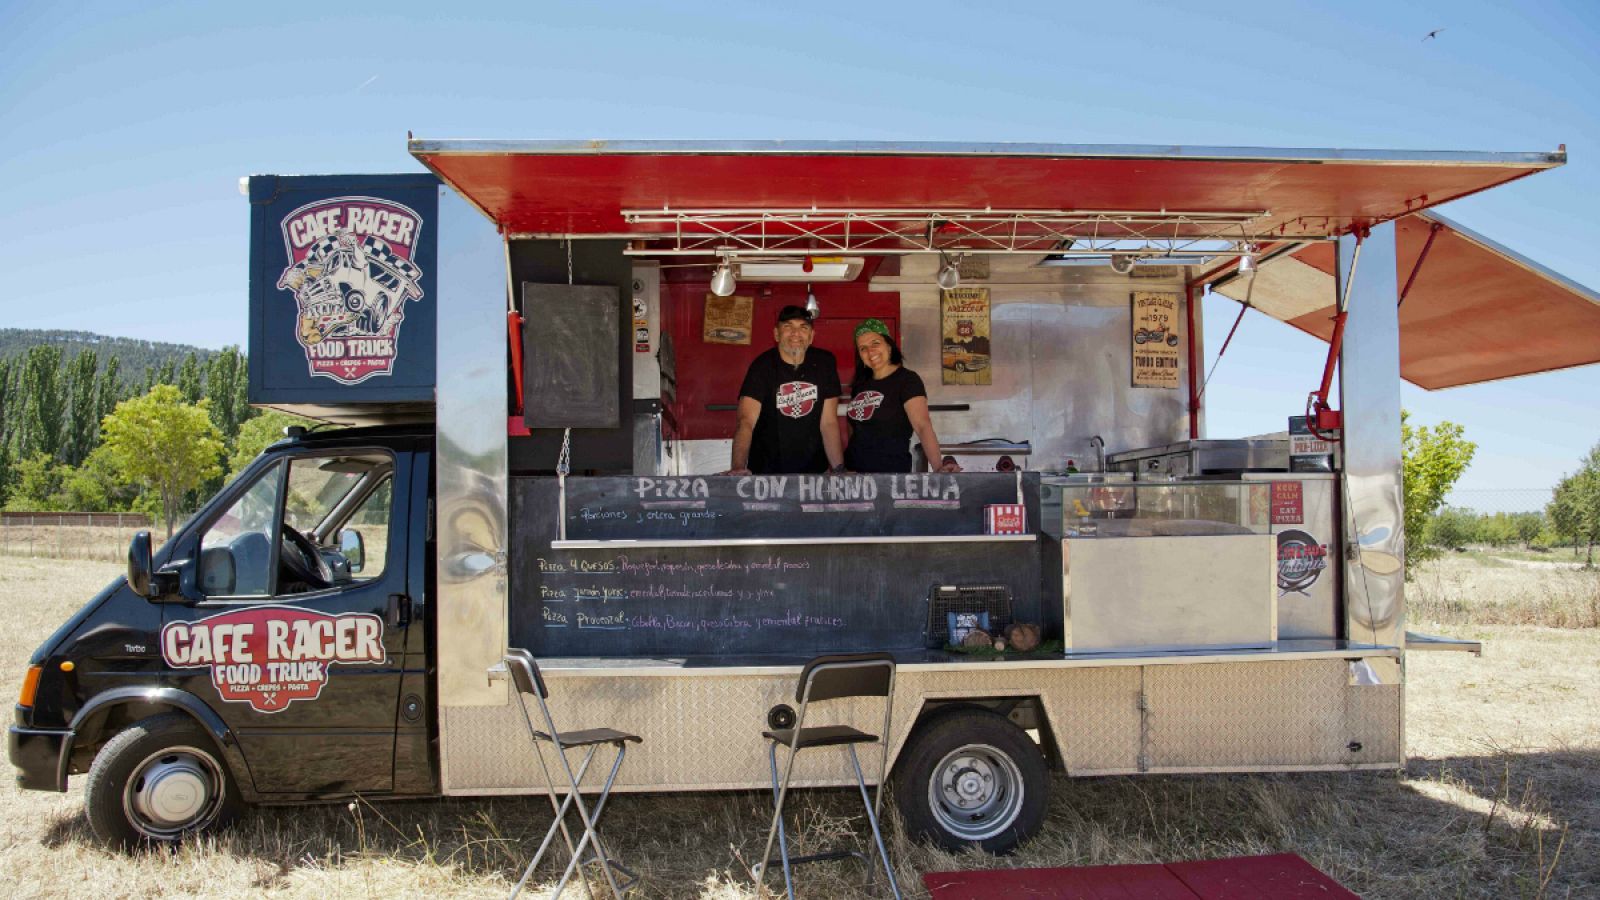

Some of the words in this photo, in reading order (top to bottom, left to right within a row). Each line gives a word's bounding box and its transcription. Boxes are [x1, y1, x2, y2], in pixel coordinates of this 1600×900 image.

[290, 207, 342, 248] CAFE
[348, 207, 415, 246] RACER
[309, 340, 345, 358] FOOD
[347, 339, 393, 357] TRUCK
[736, 475, 788, 500] CON
[570, 559, 578, 570] 4
[166, 624, 254, 663] CAFE
[267, 618, 382, 661] RACER
[216, 663, 261, 685] FOOD
[267, 661, 323, 683] TRUCK
[230, 684, 249, 692] PIZZA
[288, 683, 309, 691] PASTA
